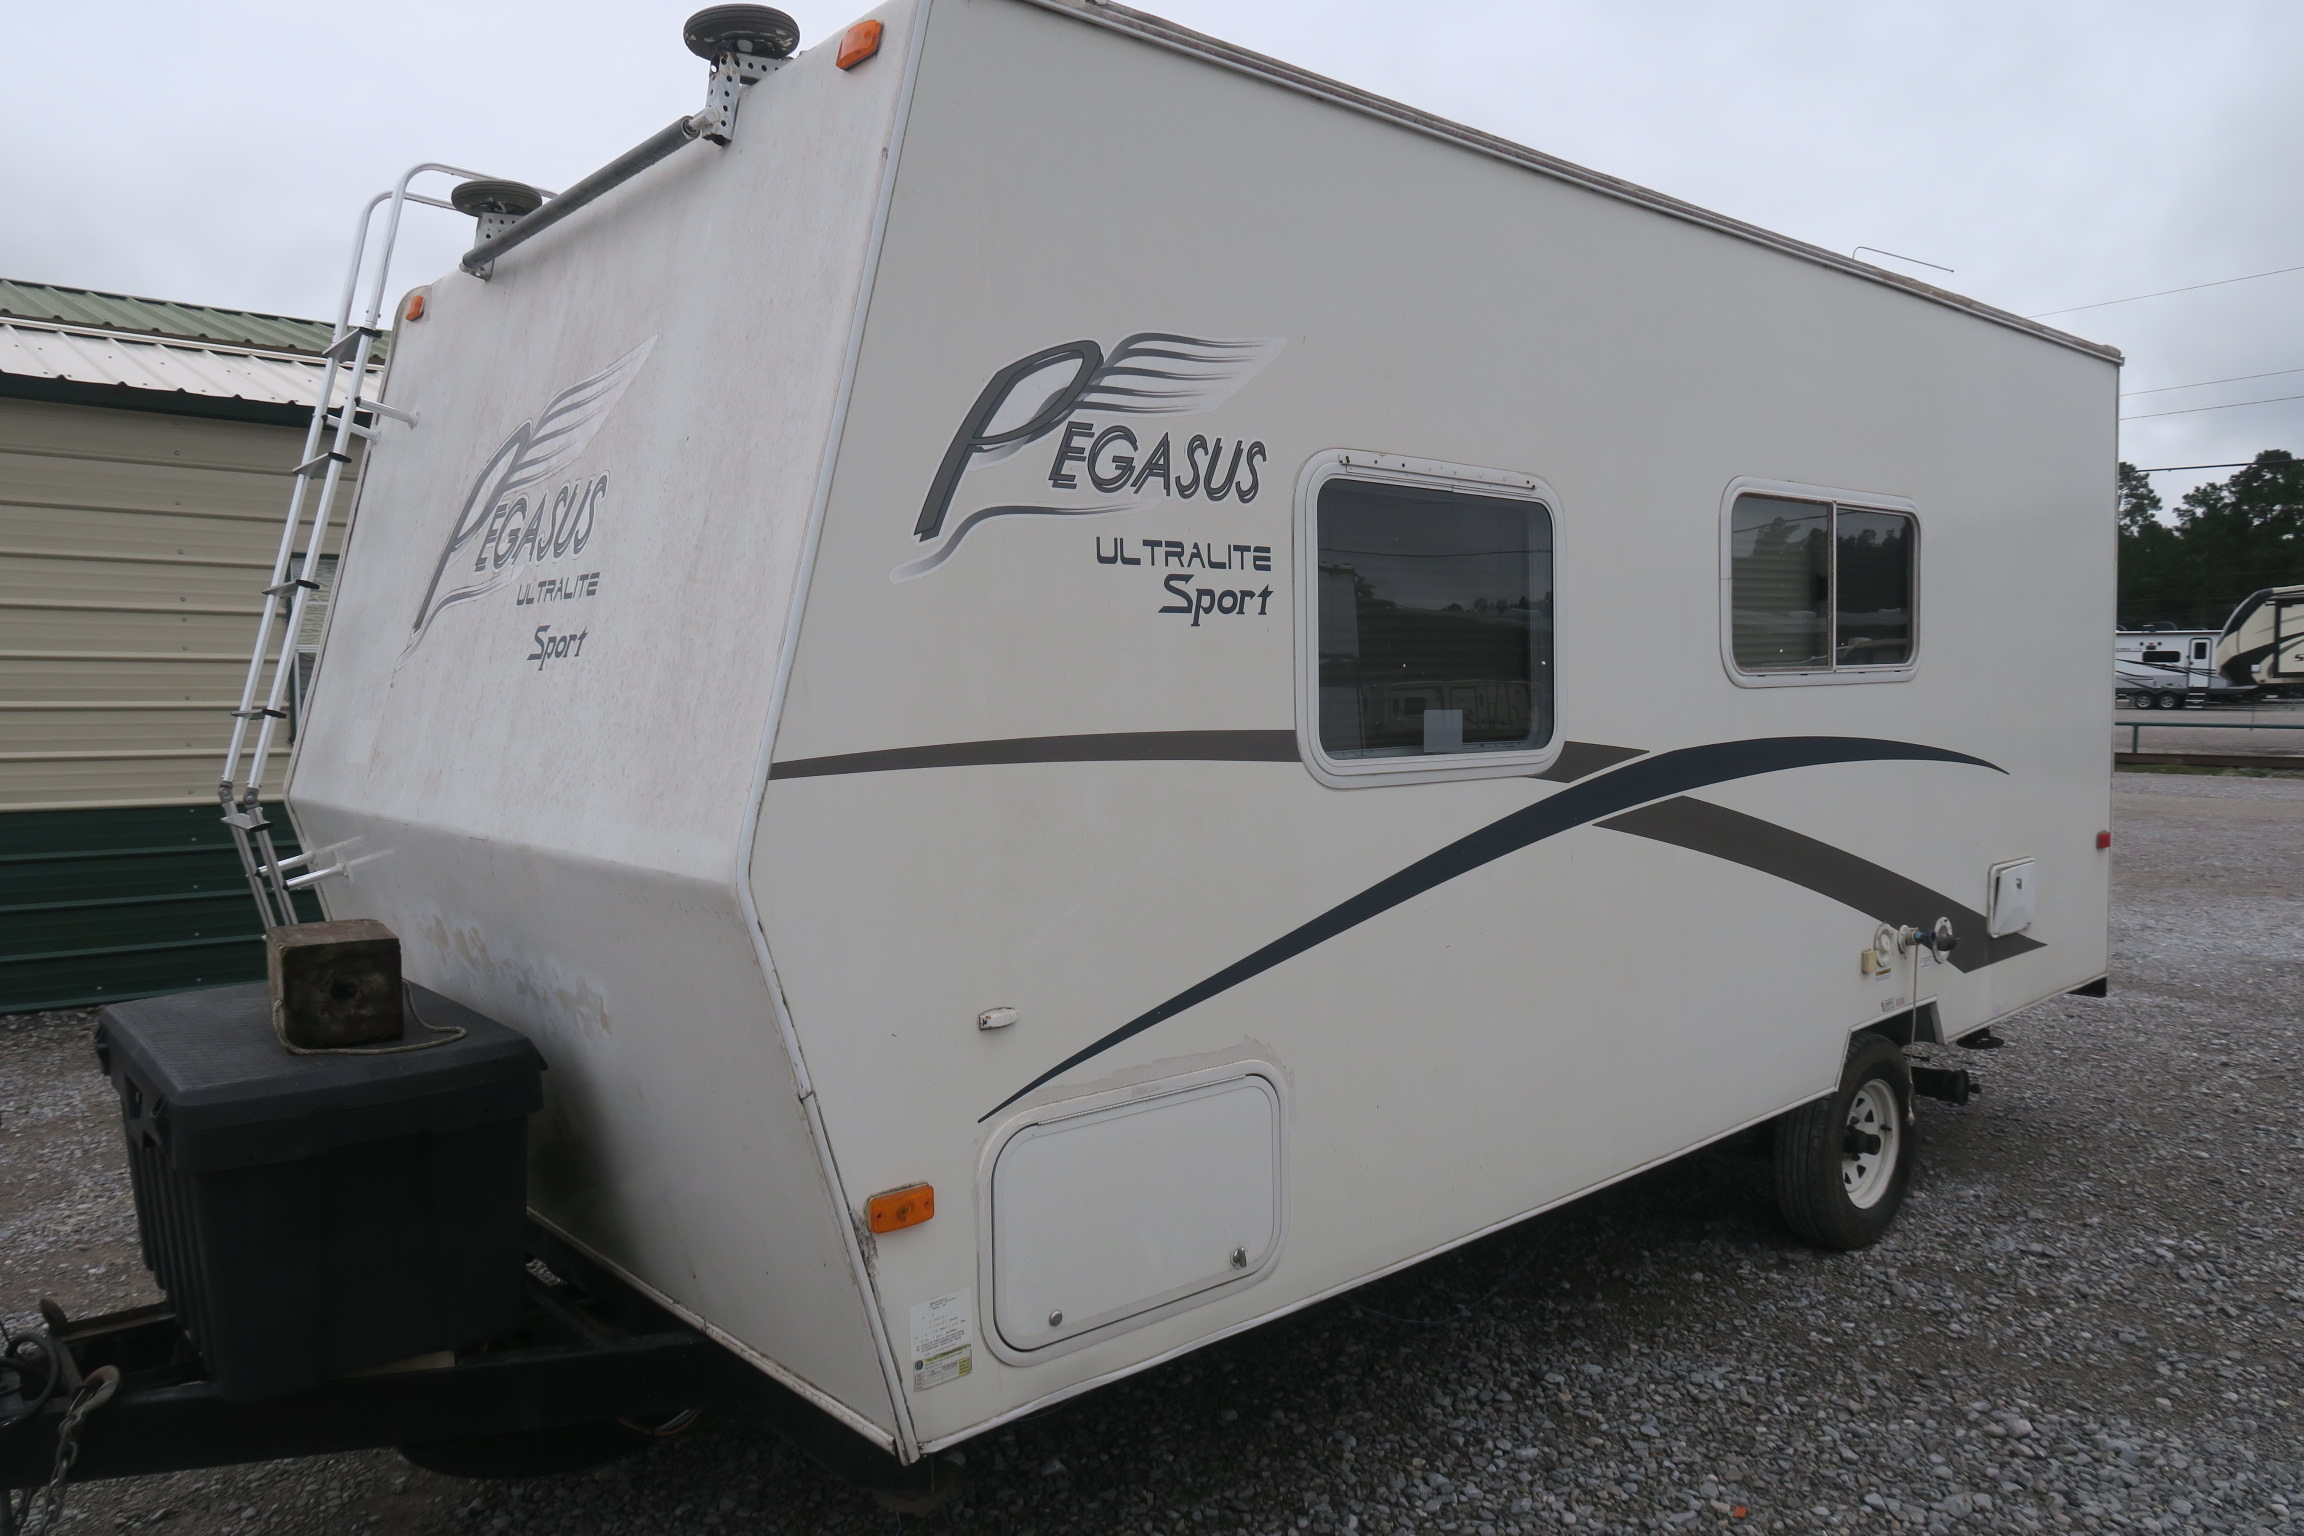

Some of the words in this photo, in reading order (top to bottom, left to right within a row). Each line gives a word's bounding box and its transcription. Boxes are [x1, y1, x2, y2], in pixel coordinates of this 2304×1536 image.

[913, 340, 1267, 542] PEGASUS
[413, 422, 608, 634] PEGASUS
[1096, 536, 1272, 572] ULTRALITE
[516, 571, 601, 606] ULTRALITE
[1157, 573, 1274, 627] Sport
[526, 625, 588, 671] Sport
